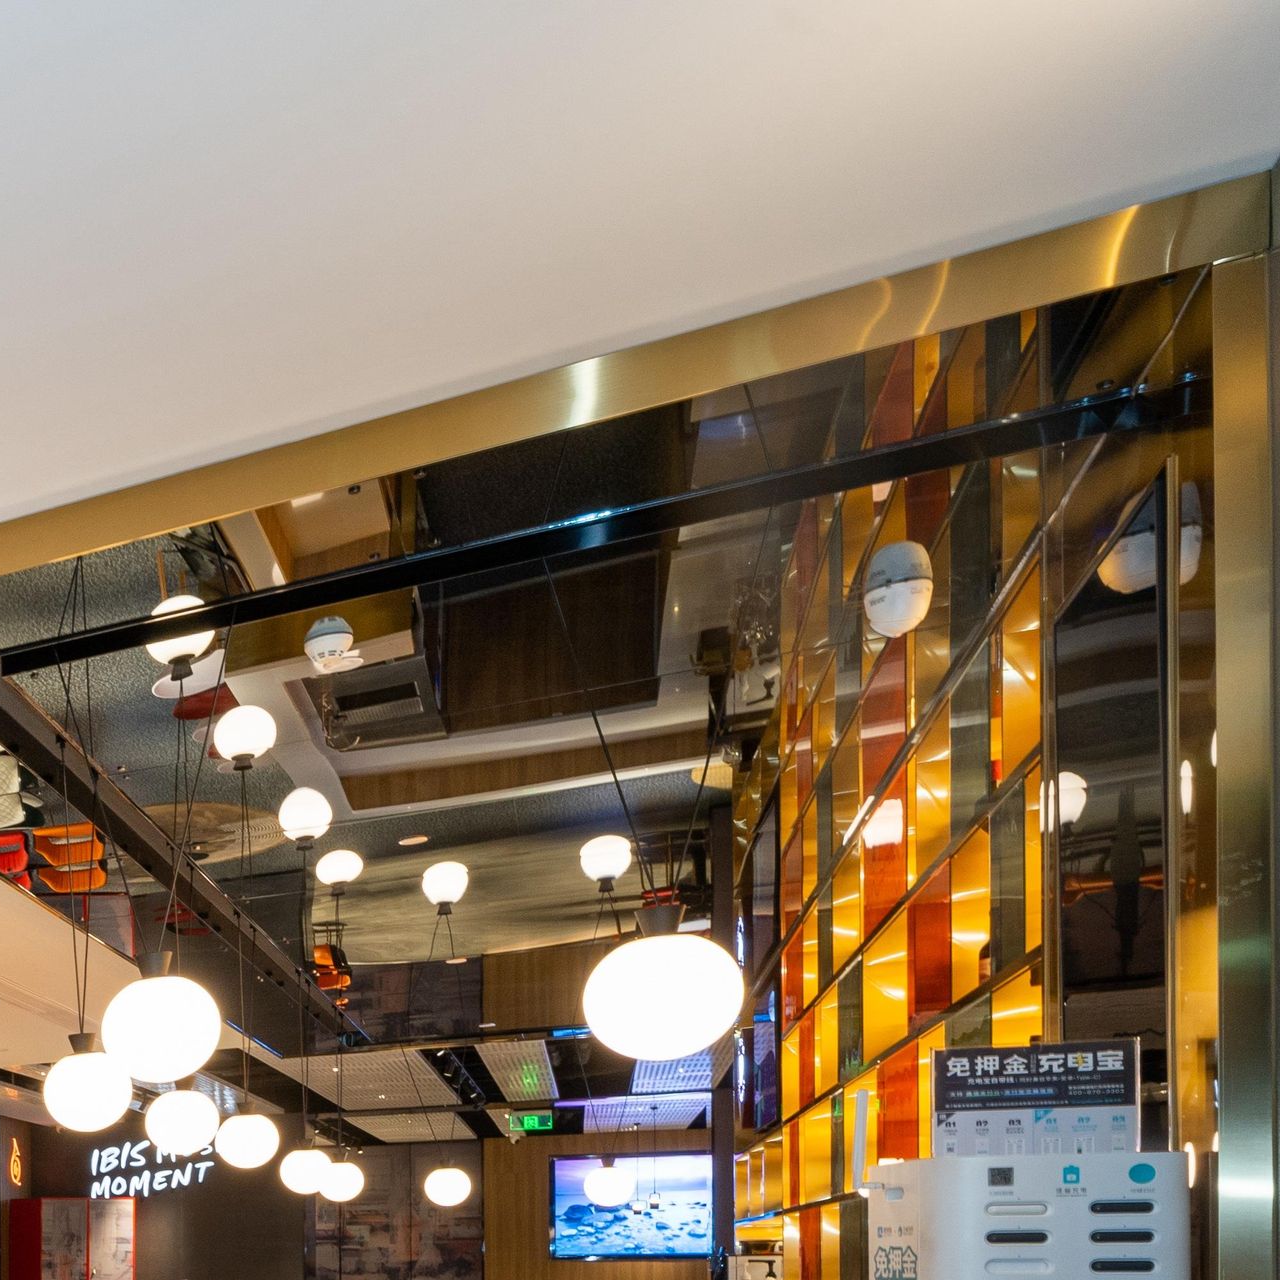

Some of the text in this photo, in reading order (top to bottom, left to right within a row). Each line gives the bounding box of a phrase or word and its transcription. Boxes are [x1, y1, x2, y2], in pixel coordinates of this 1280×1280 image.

[946, 1054, 1029, 1077] 免押金
[1038, 1050, 1125, 1073] 充电宝
[91, 1140, 150, 1176] IBIS
[91, 1162, 215, 1199] MOMENT
[874, 1246, 917, 1279] 免押金
